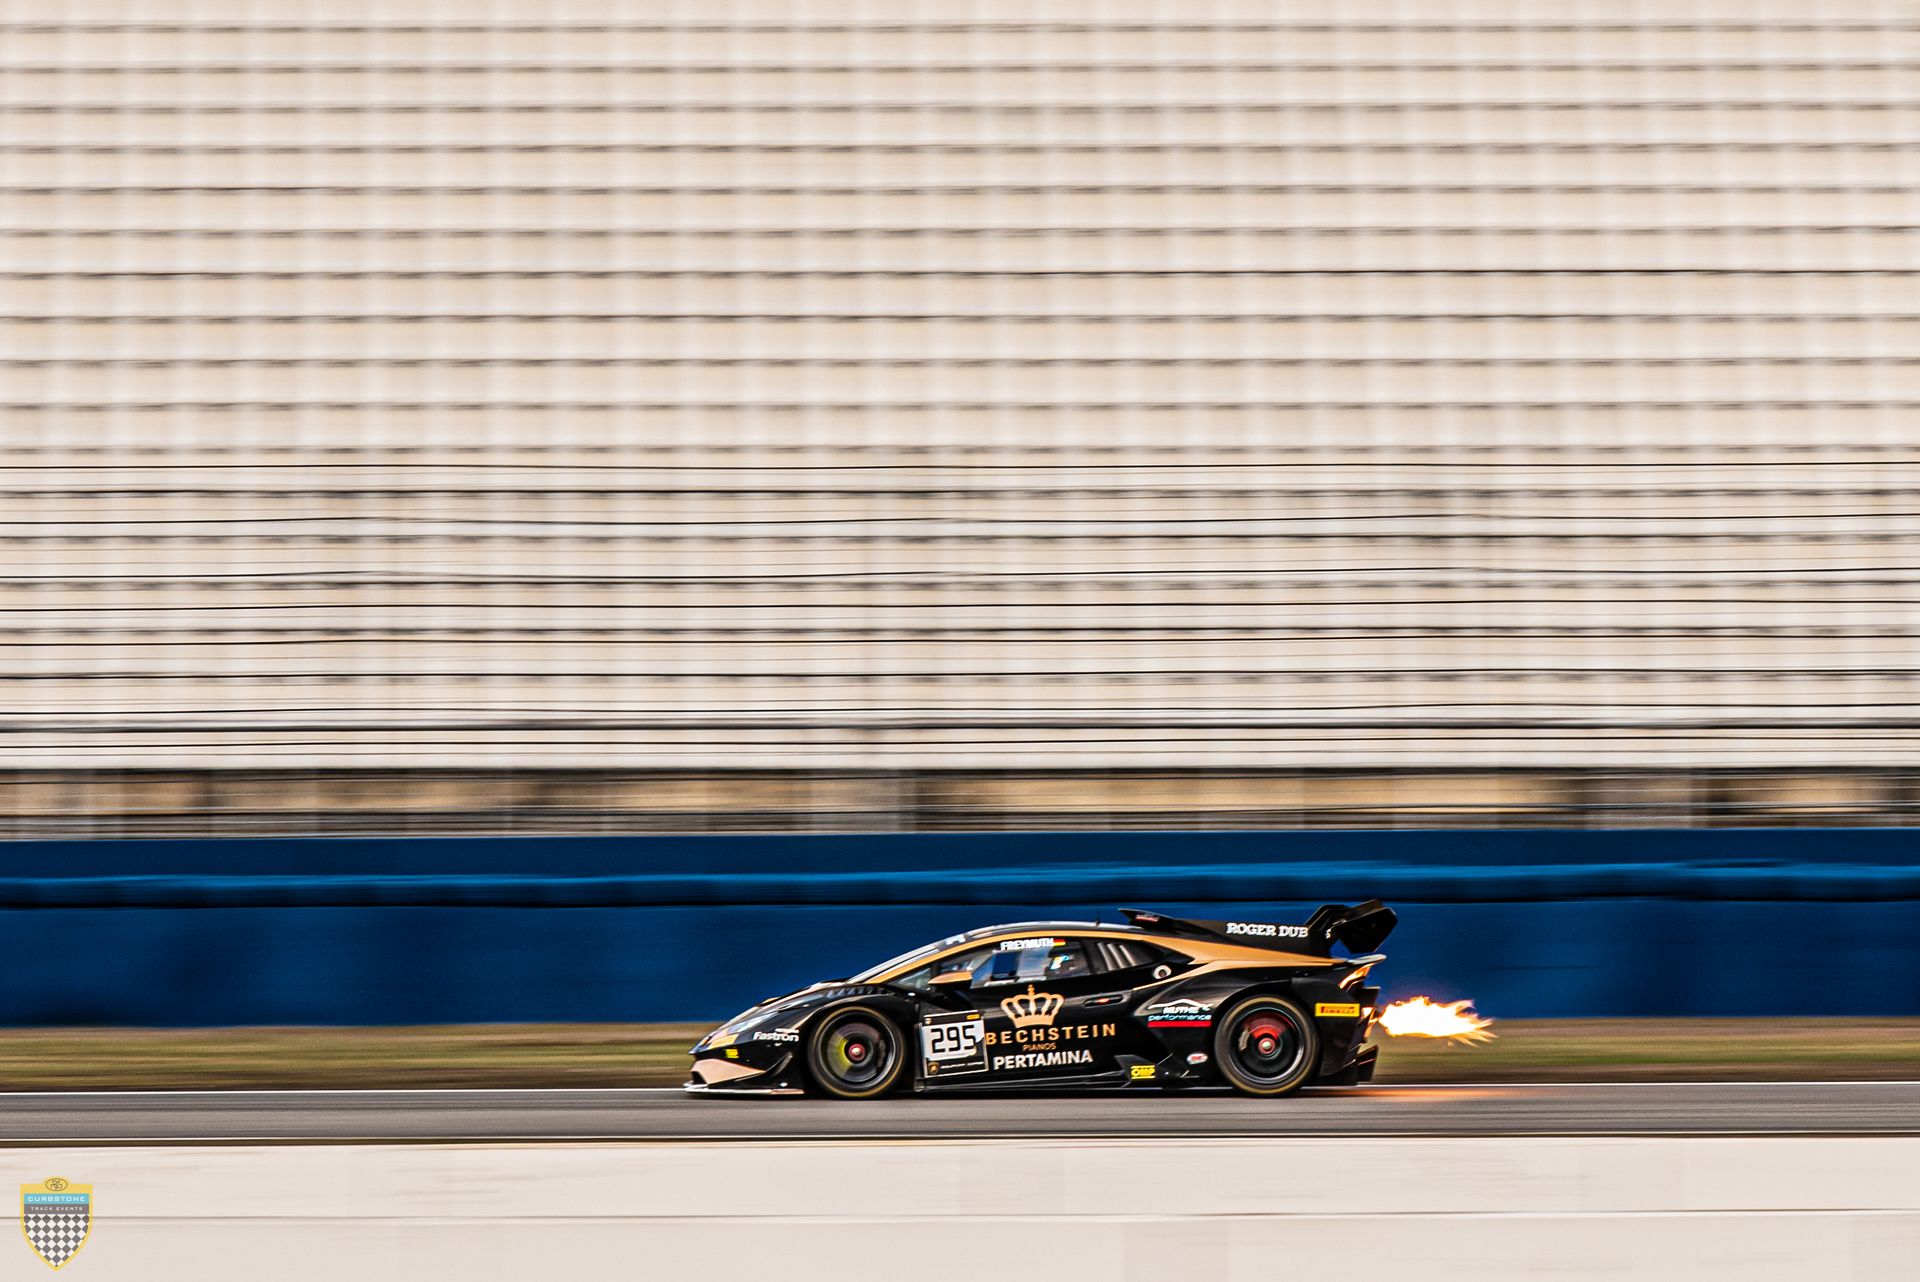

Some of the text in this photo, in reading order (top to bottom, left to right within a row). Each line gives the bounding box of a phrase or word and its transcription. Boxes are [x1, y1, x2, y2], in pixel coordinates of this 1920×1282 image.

[1226, 923, 1277, 936] ROGER
[753, 1031, 800, 1042] Fastron
[930, 1024, 976, 1053] 295
[985, 1023, 1116, 1045] BECHSTEIN
[1022, 1042, 1057, 1052] PIANOS
[993, 1049, 1094, 1071] PERTAMINA
